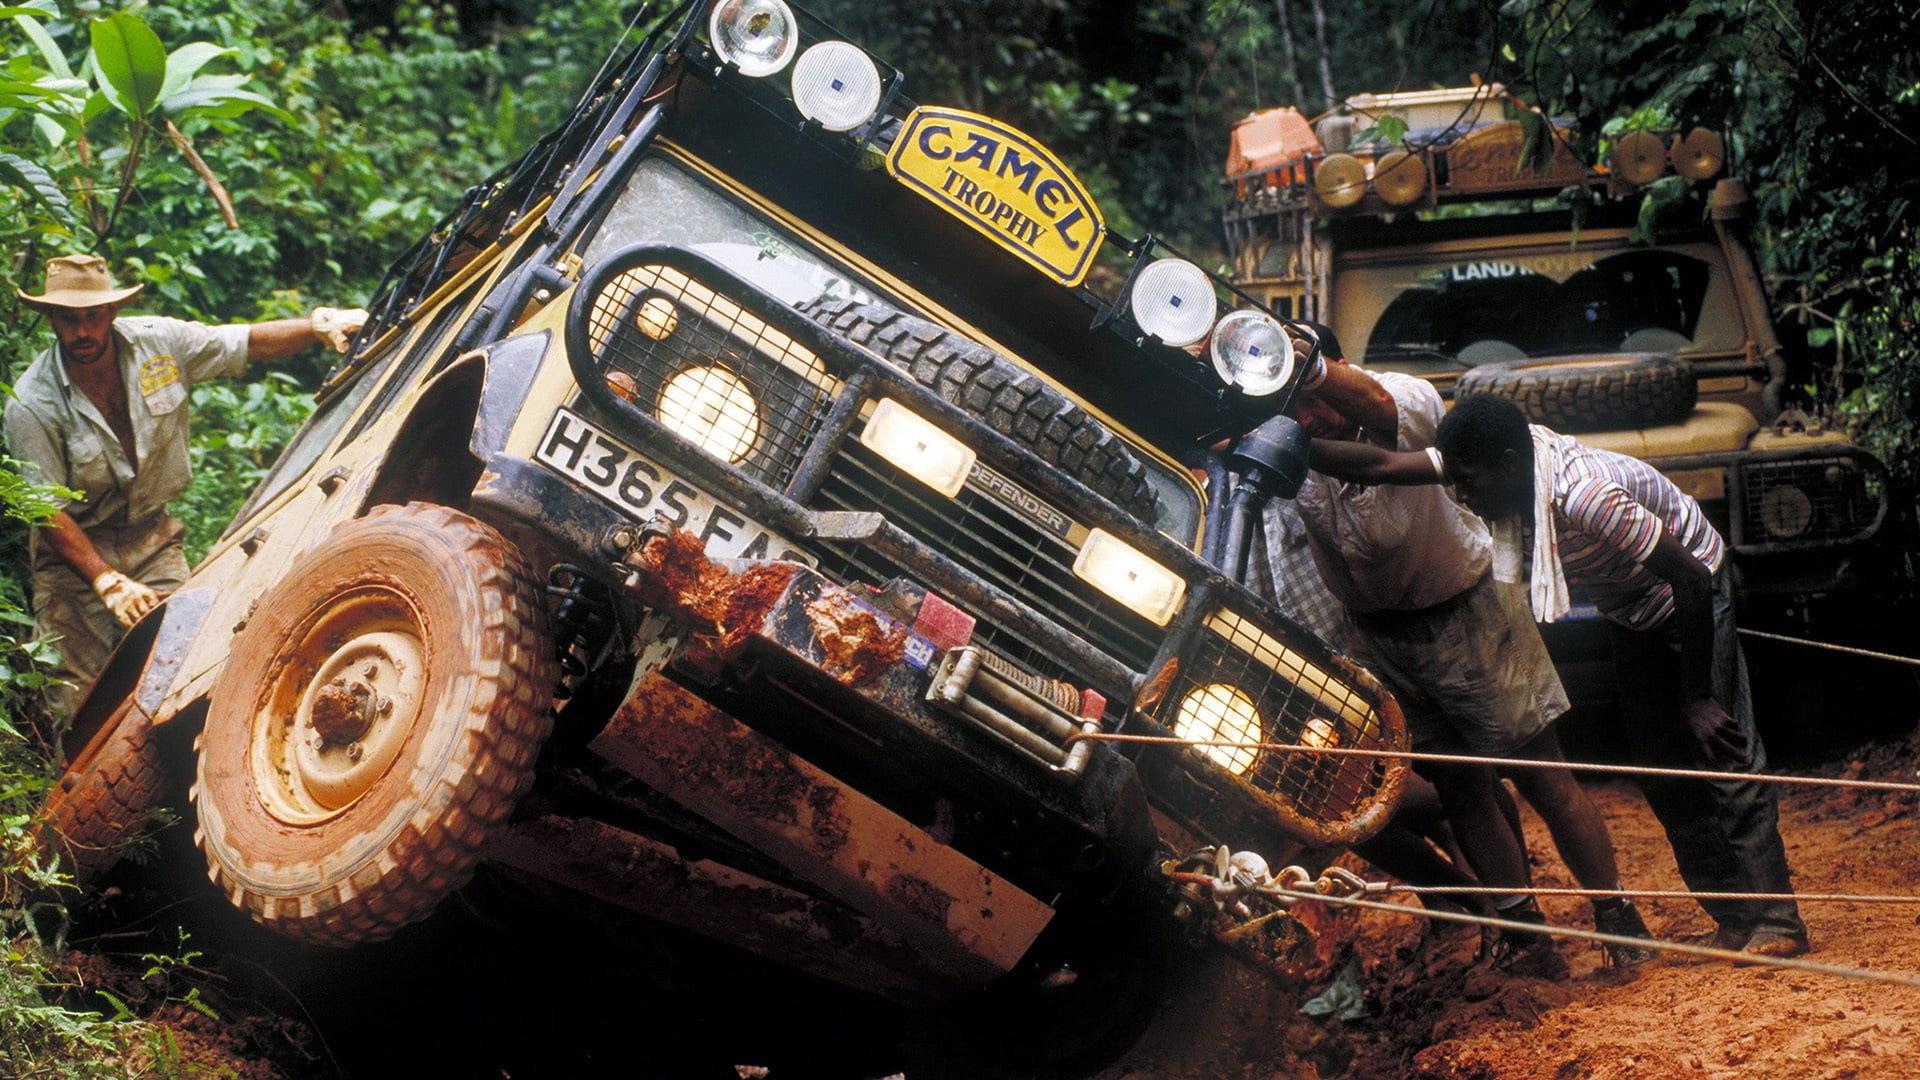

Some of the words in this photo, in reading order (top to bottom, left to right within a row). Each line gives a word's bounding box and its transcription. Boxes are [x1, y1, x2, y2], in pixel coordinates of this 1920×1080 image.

[918, 125, 1085, 250] CAMEL
[940, 166, 1048, 248] TROPHY
[1452, 261, 1515, 281] LAND
[545, 415, 698, 528] H365
[699, 503, 811, 566] FA
[968, 463, 1063, 530] DEFENDER
